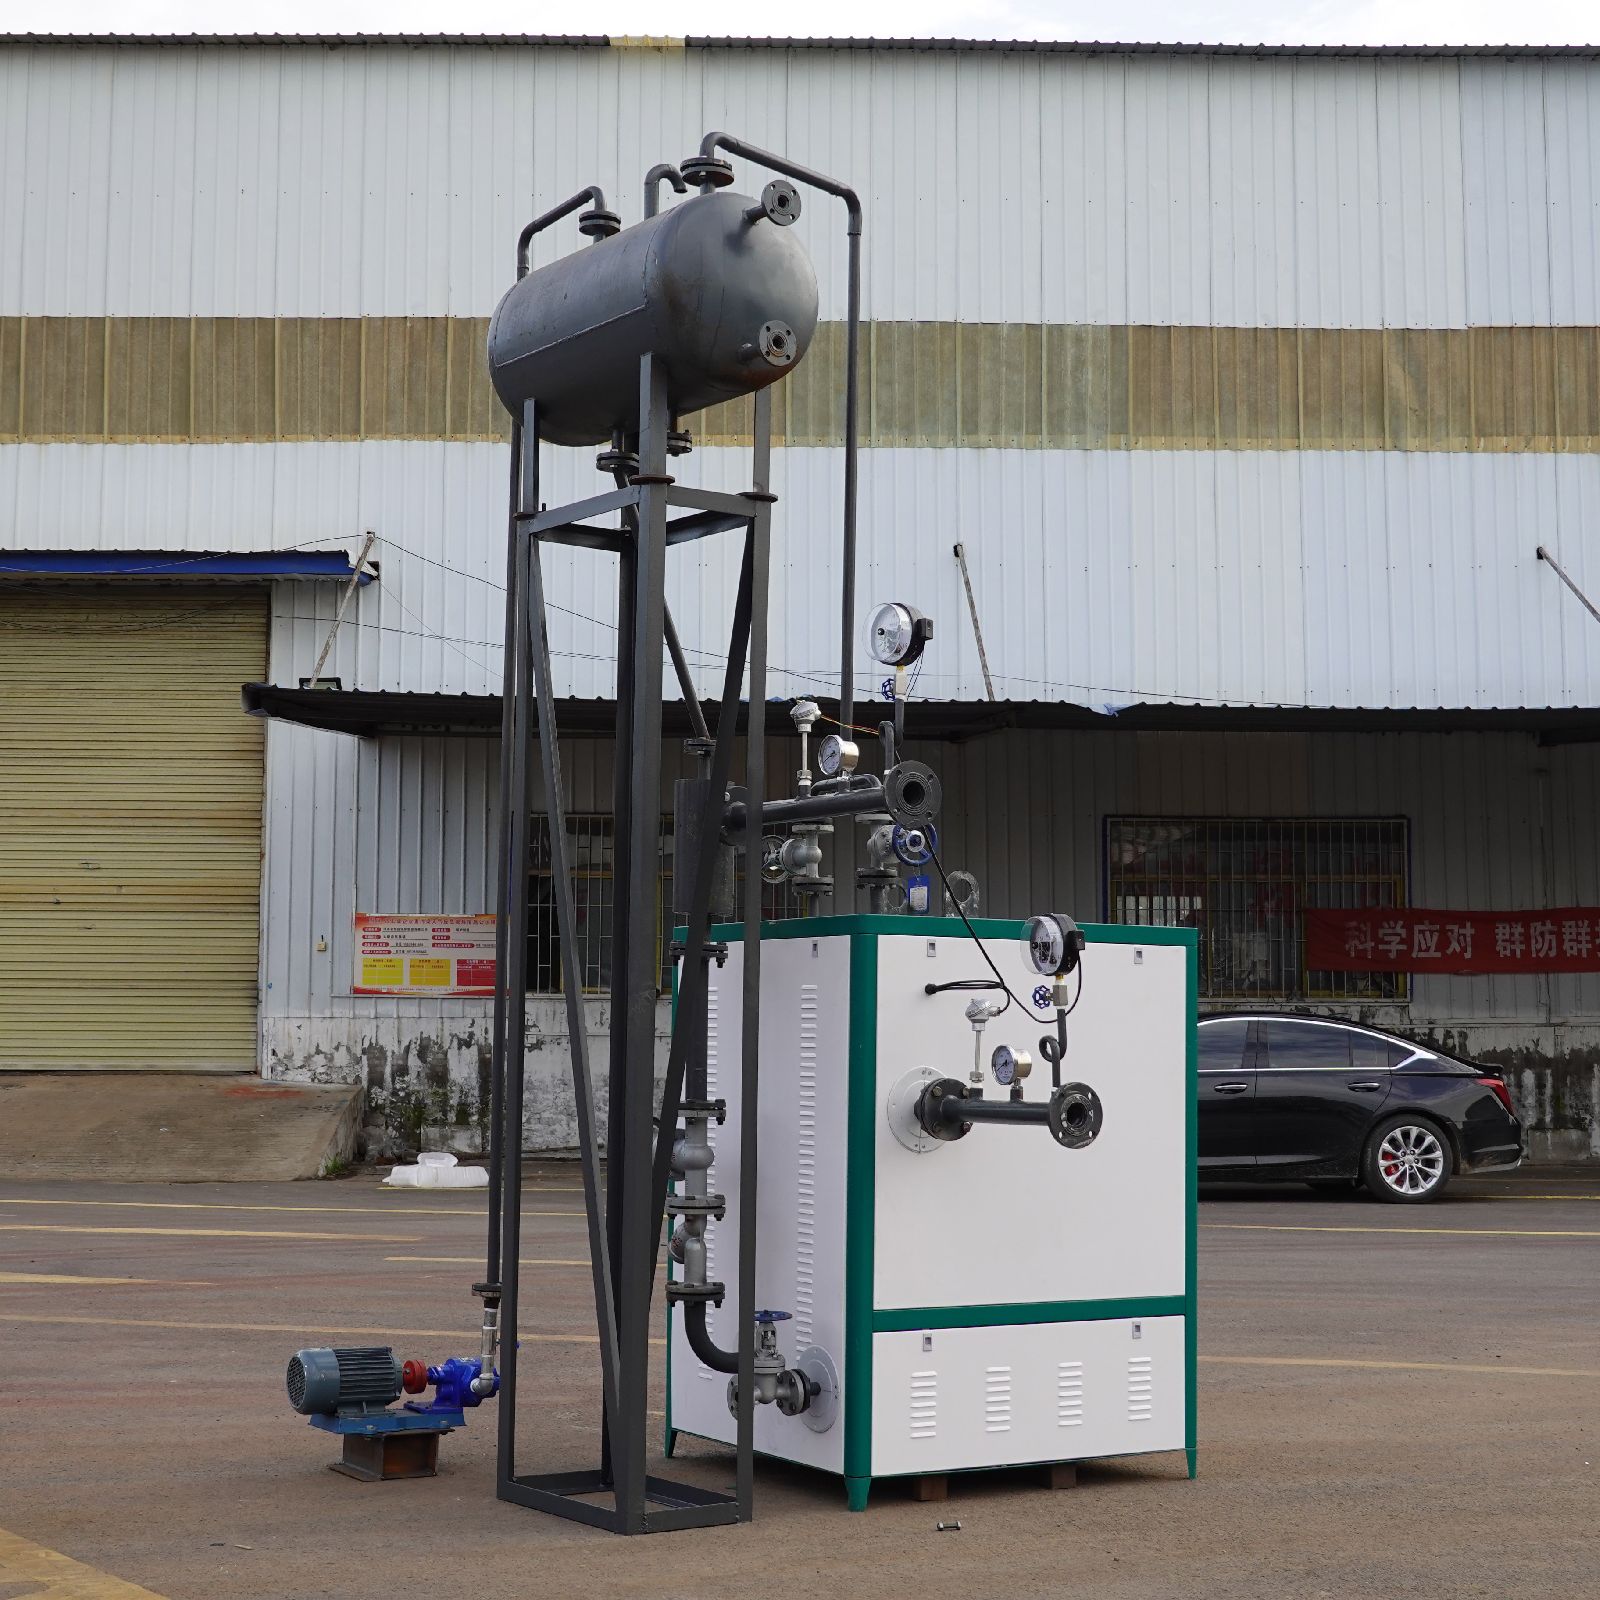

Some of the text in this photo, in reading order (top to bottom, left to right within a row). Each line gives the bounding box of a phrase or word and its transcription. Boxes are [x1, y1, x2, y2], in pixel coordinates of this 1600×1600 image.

[1345, 920, 1600, 959] 科学应对 群防群
